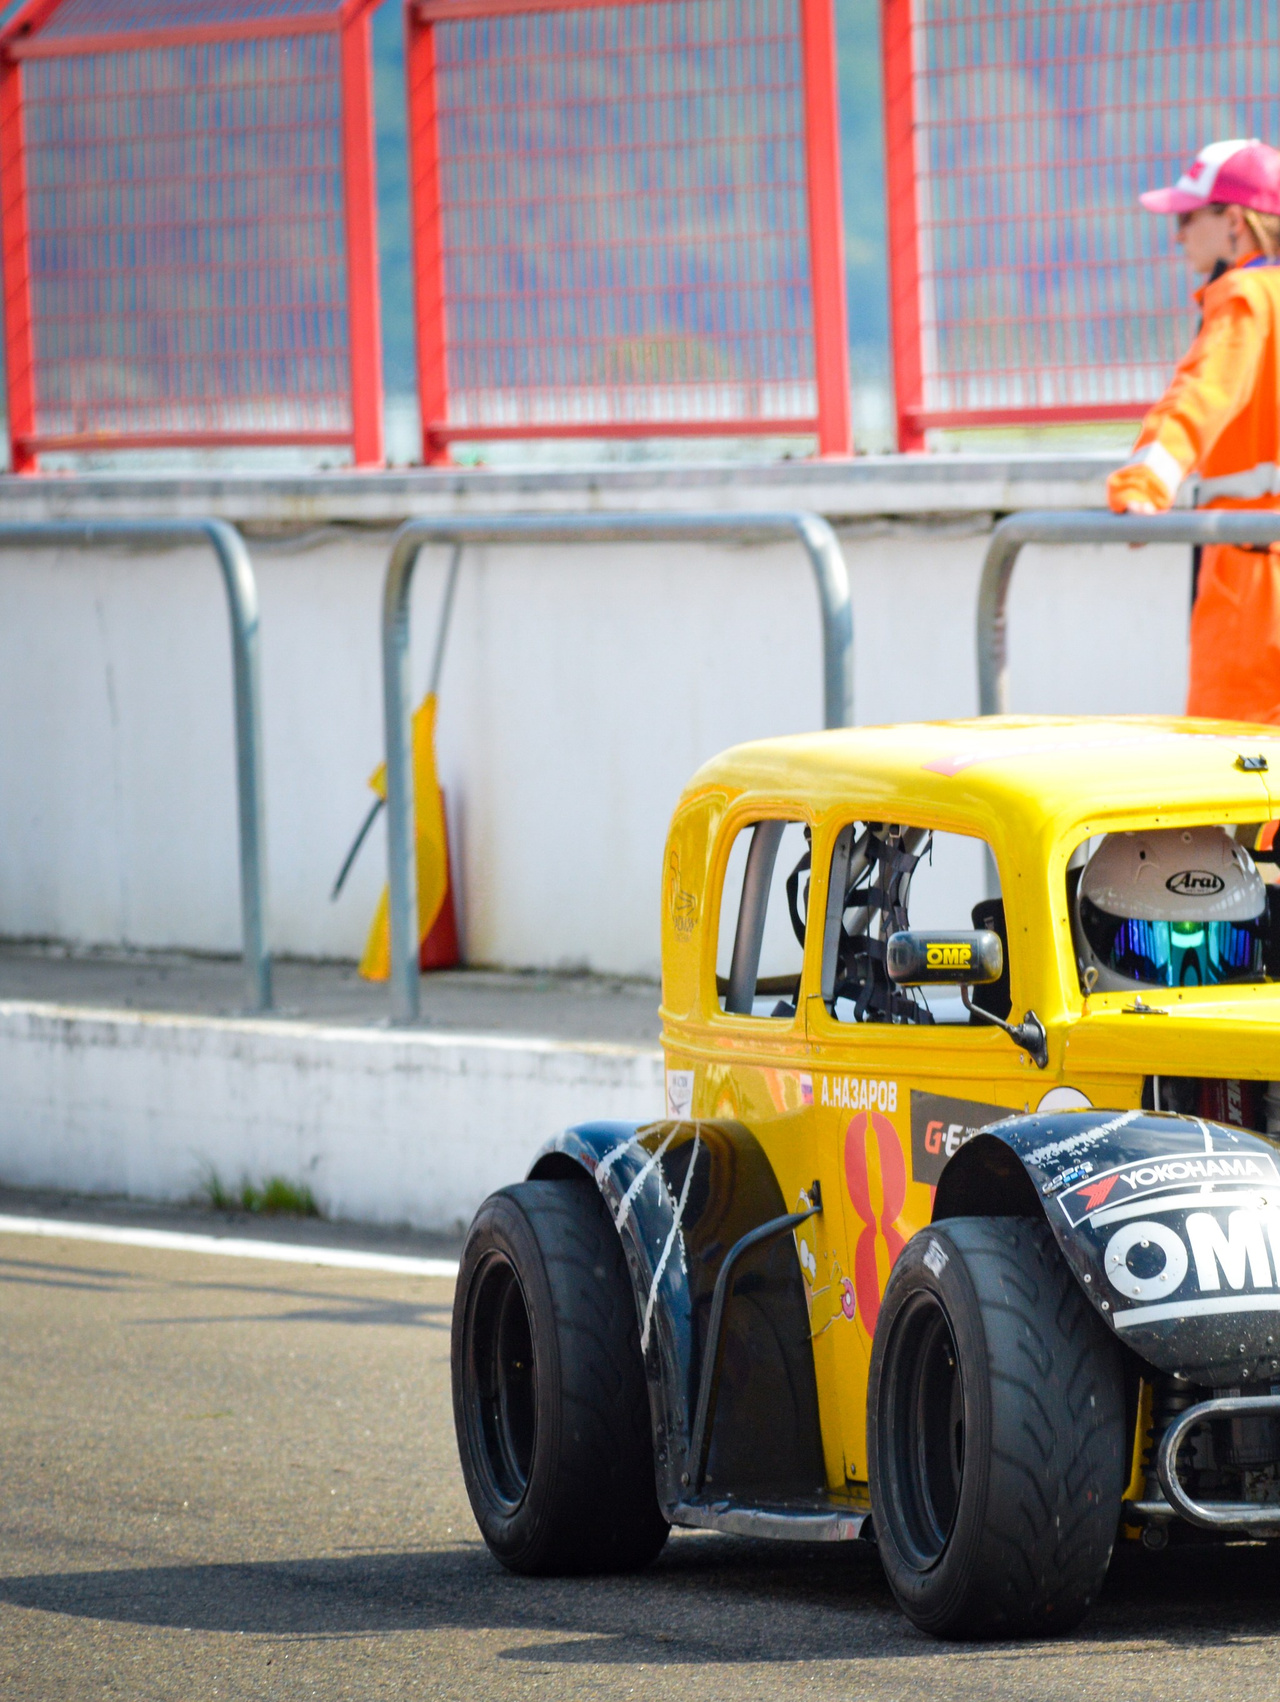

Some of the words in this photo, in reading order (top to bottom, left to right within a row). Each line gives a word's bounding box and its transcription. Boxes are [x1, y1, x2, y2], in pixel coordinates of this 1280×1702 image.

[1171, 871, 1219, 889] Arai
[926, 948, 972, 965] OMP
[821, 1075, 898, 1113] А.НАЗАРОВ
[1120, 1158, 1265, 1190] YOKOHAMA
